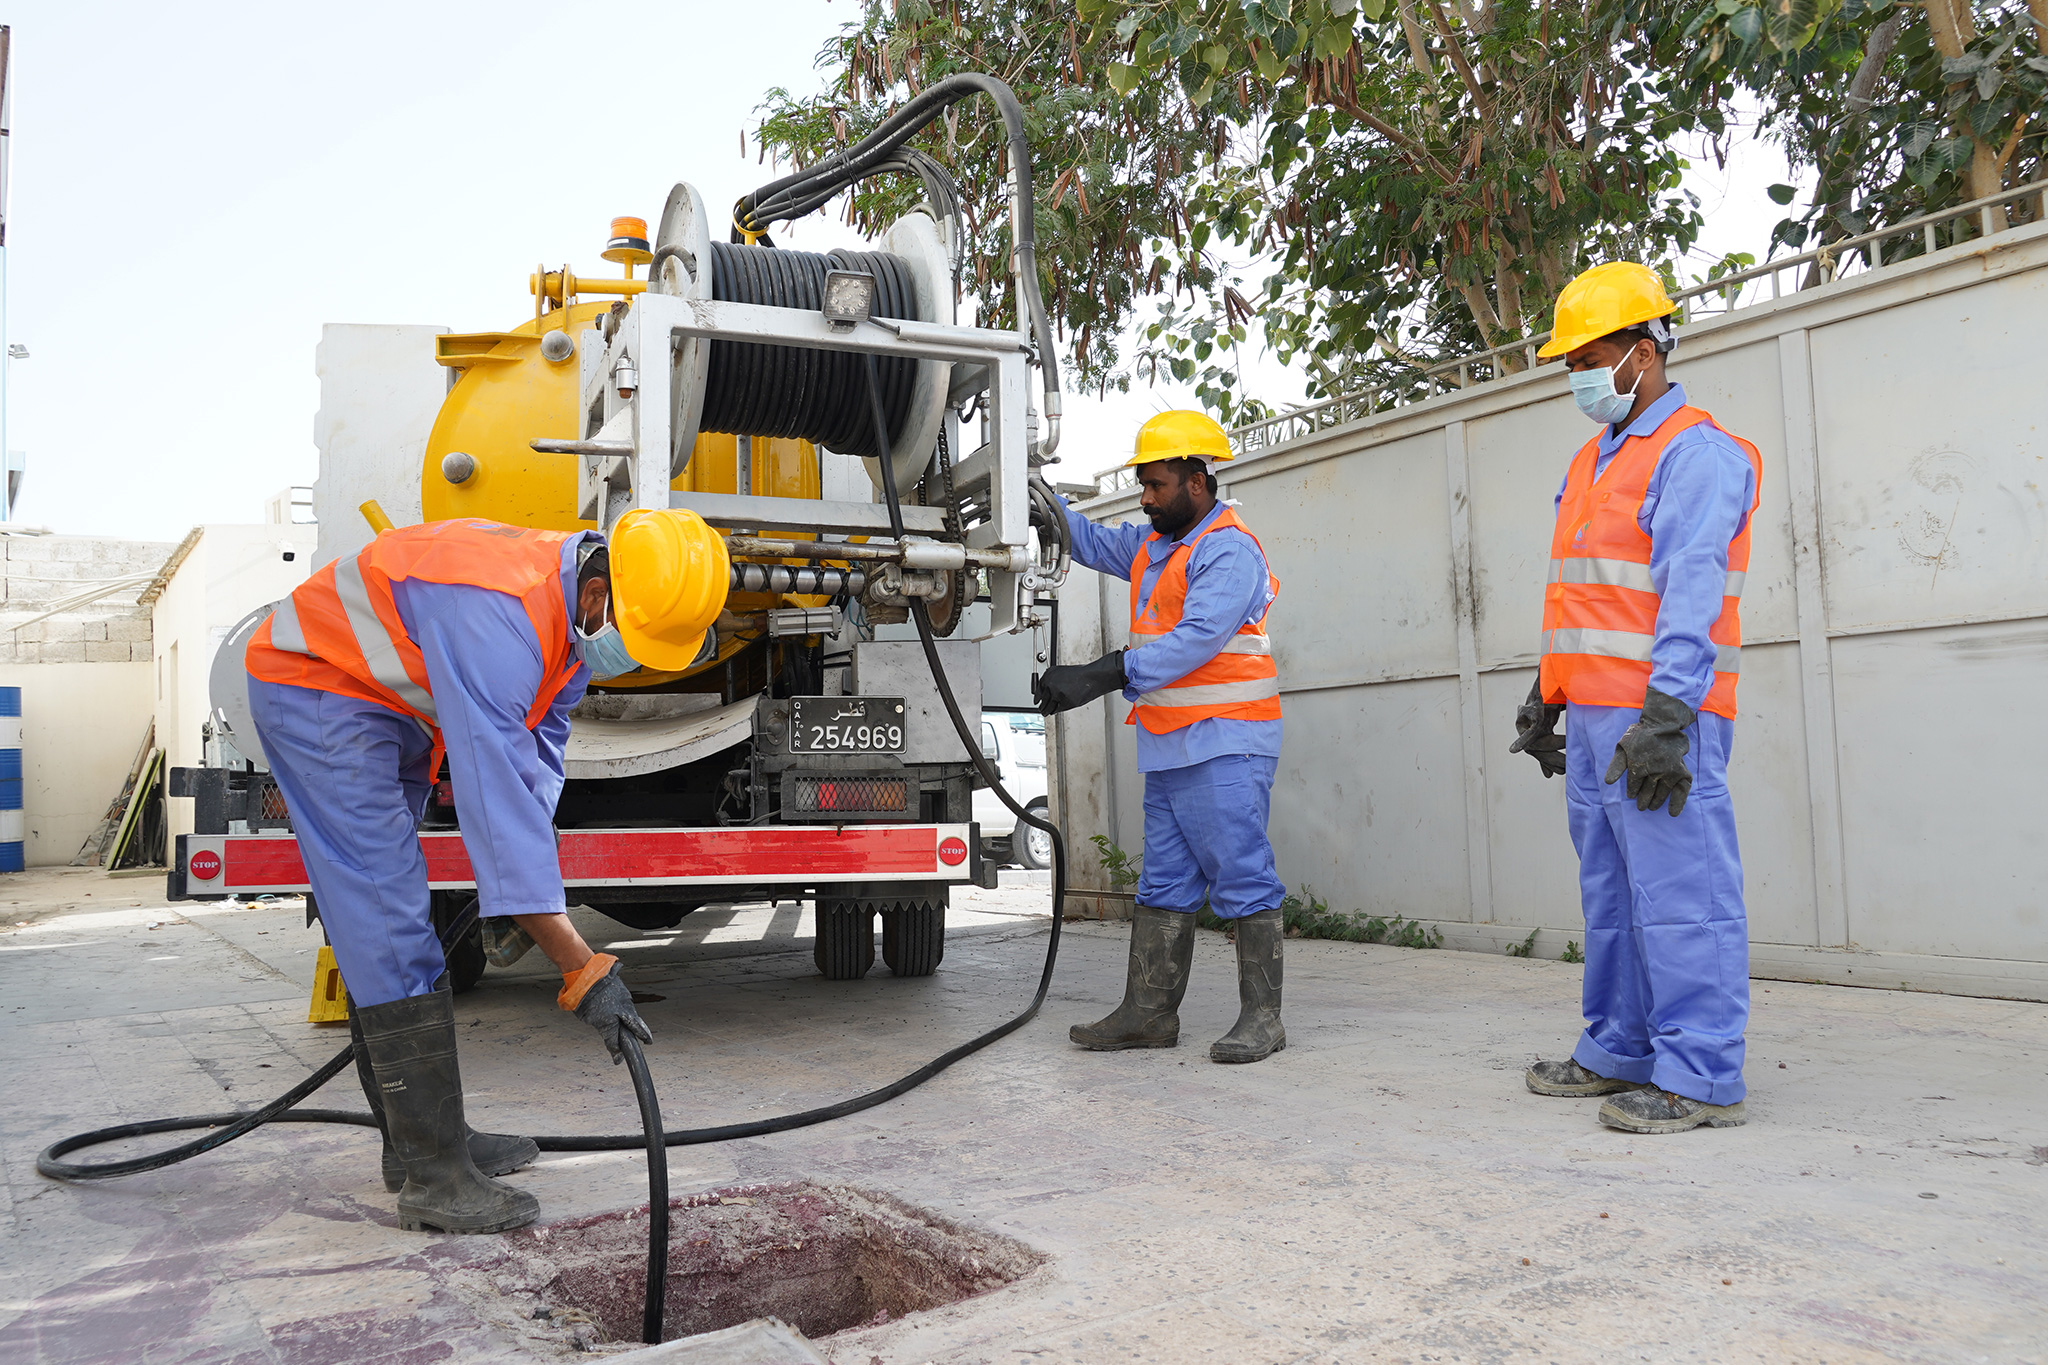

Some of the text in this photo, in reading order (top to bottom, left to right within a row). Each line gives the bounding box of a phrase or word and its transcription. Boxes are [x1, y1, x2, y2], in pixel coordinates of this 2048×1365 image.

[830, 701, 866, 721] قطر
[810, 725, 902, 750] 254969
[192, 861, 218, 869] STOP
